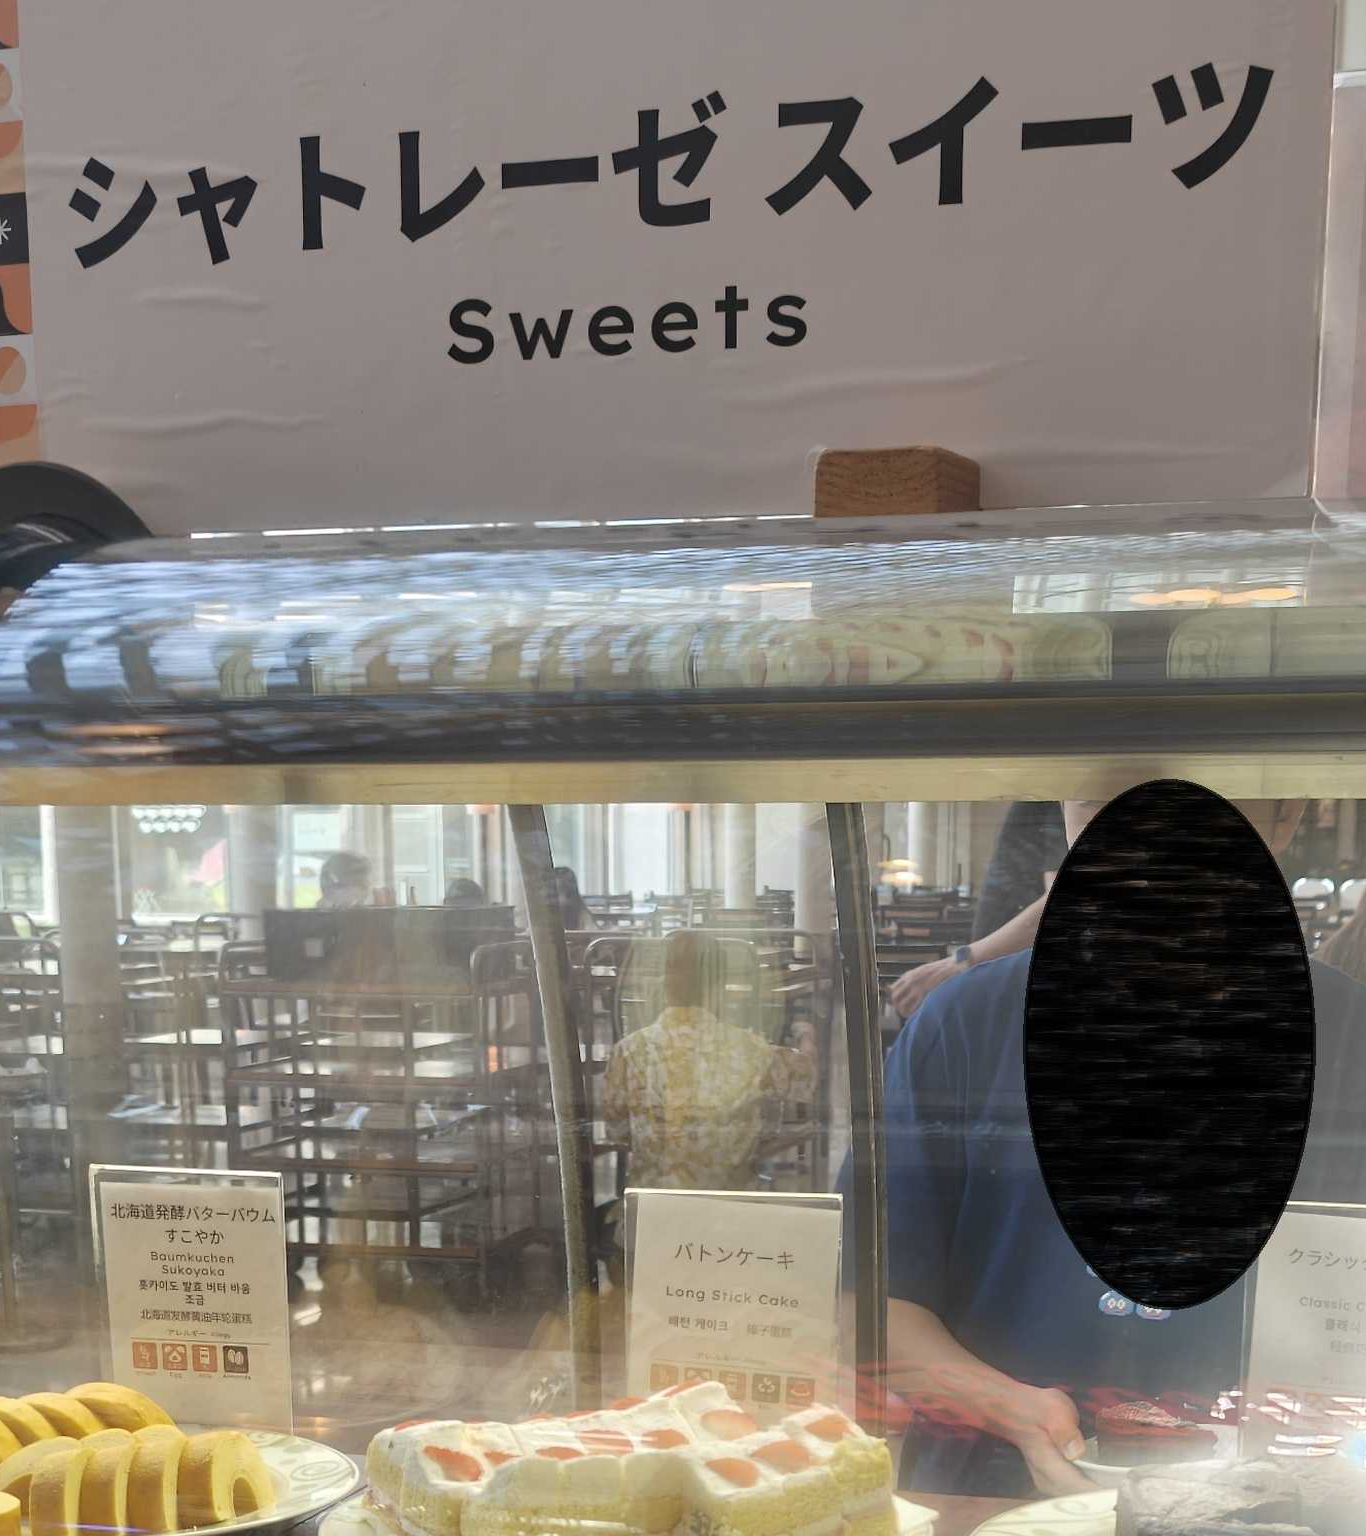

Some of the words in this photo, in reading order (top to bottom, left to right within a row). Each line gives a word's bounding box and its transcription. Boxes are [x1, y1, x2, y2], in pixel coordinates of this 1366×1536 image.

[67, 90, 728, 268] シャトレーゼ
[765, 62, 1275, 215] スイーツ
[446, 284, 810, 366] Sweets
[110, 1203, 276, 1223] 北海道発酵バターバウム
[165, 1228, 225, 1244] すこやか
[150, 1251, 235, 1264] Baumkuchen
[674, 1243, 796, 1270] バトンケーキ
[162, 1264, 225, 1278] Sukoyaka
[666, 1285, 706, 1301] Long
[711, 1289, 752, 1304] Stick
[758, 1294, 800, 1309] Cake
[1298, 1295, 1352, 1312] Classic
